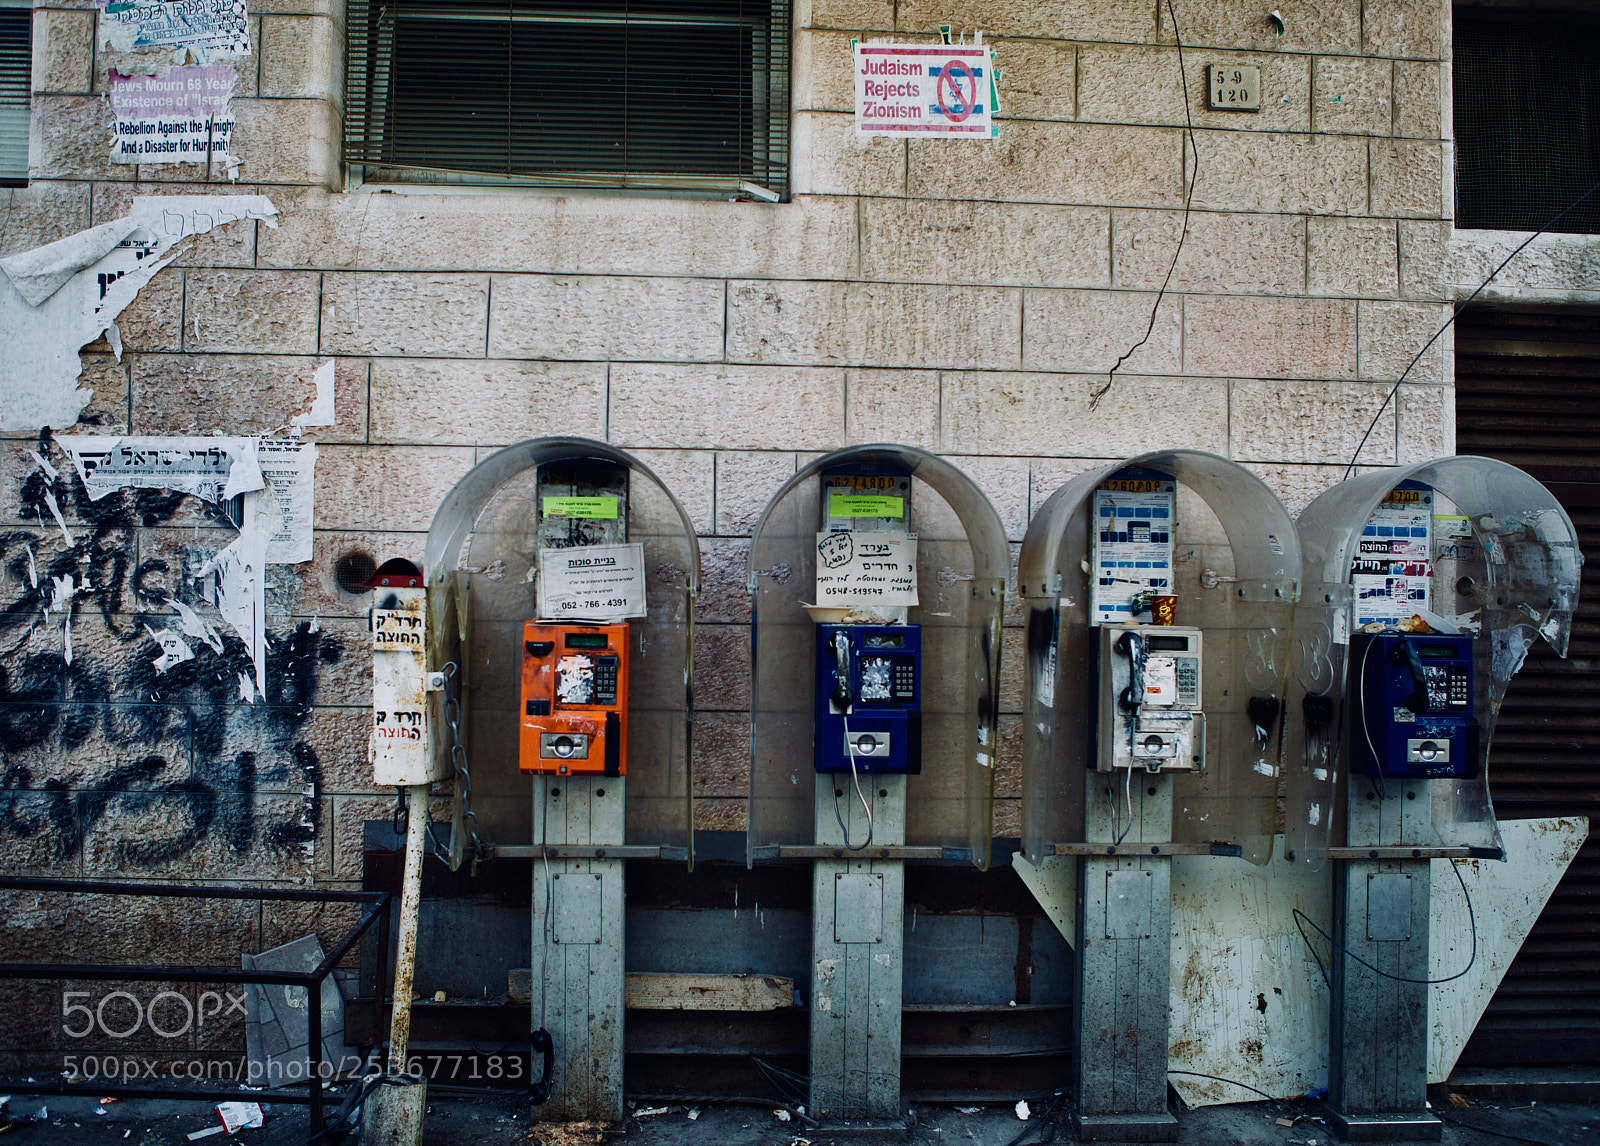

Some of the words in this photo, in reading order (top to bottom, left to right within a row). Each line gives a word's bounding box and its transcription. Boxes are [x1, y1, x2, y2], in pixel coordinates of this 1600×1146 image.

[861, 59, 922, 76] Judaism
[111, 80, 142, 93] Jews
[146, 79, 184, 92] Mourn
[187, 78, 202, 91] 68
[865, 80, 920, 101] Rejects
[114, 95, 173, 108] Existence
[177, 94, 188, 106] of
[1217, 89, 1248, 102] 120
[863, 102, 921, 118] Zionism
[119, 121, 155, 135] Rebellion
[158, 120, 187, 138] Against
[189, 120, 202, 132] the
[121, 140, 136, 154] And
[139, 144, 142, 153] a
[145, 140, 178, 153] Disaster
[180, 139, 190, 152] for
[189, 447, 227, 466] ילדי
[860, 544, 889, 552] בערד
[568, 559, 592, 567] סוכות
[594, 557, 616, 565] בניית
[863, 562, 898, 571] חדרים
[561, 601, 577, 610] 052
[585, 600, 600, 608] 766
[607, 599, 627, 607] 4391
[376, 613, 422, 630] חרד"ק
[376, 631, 421, 644] החוצה
[378, 727, 421, 741] החוצה
